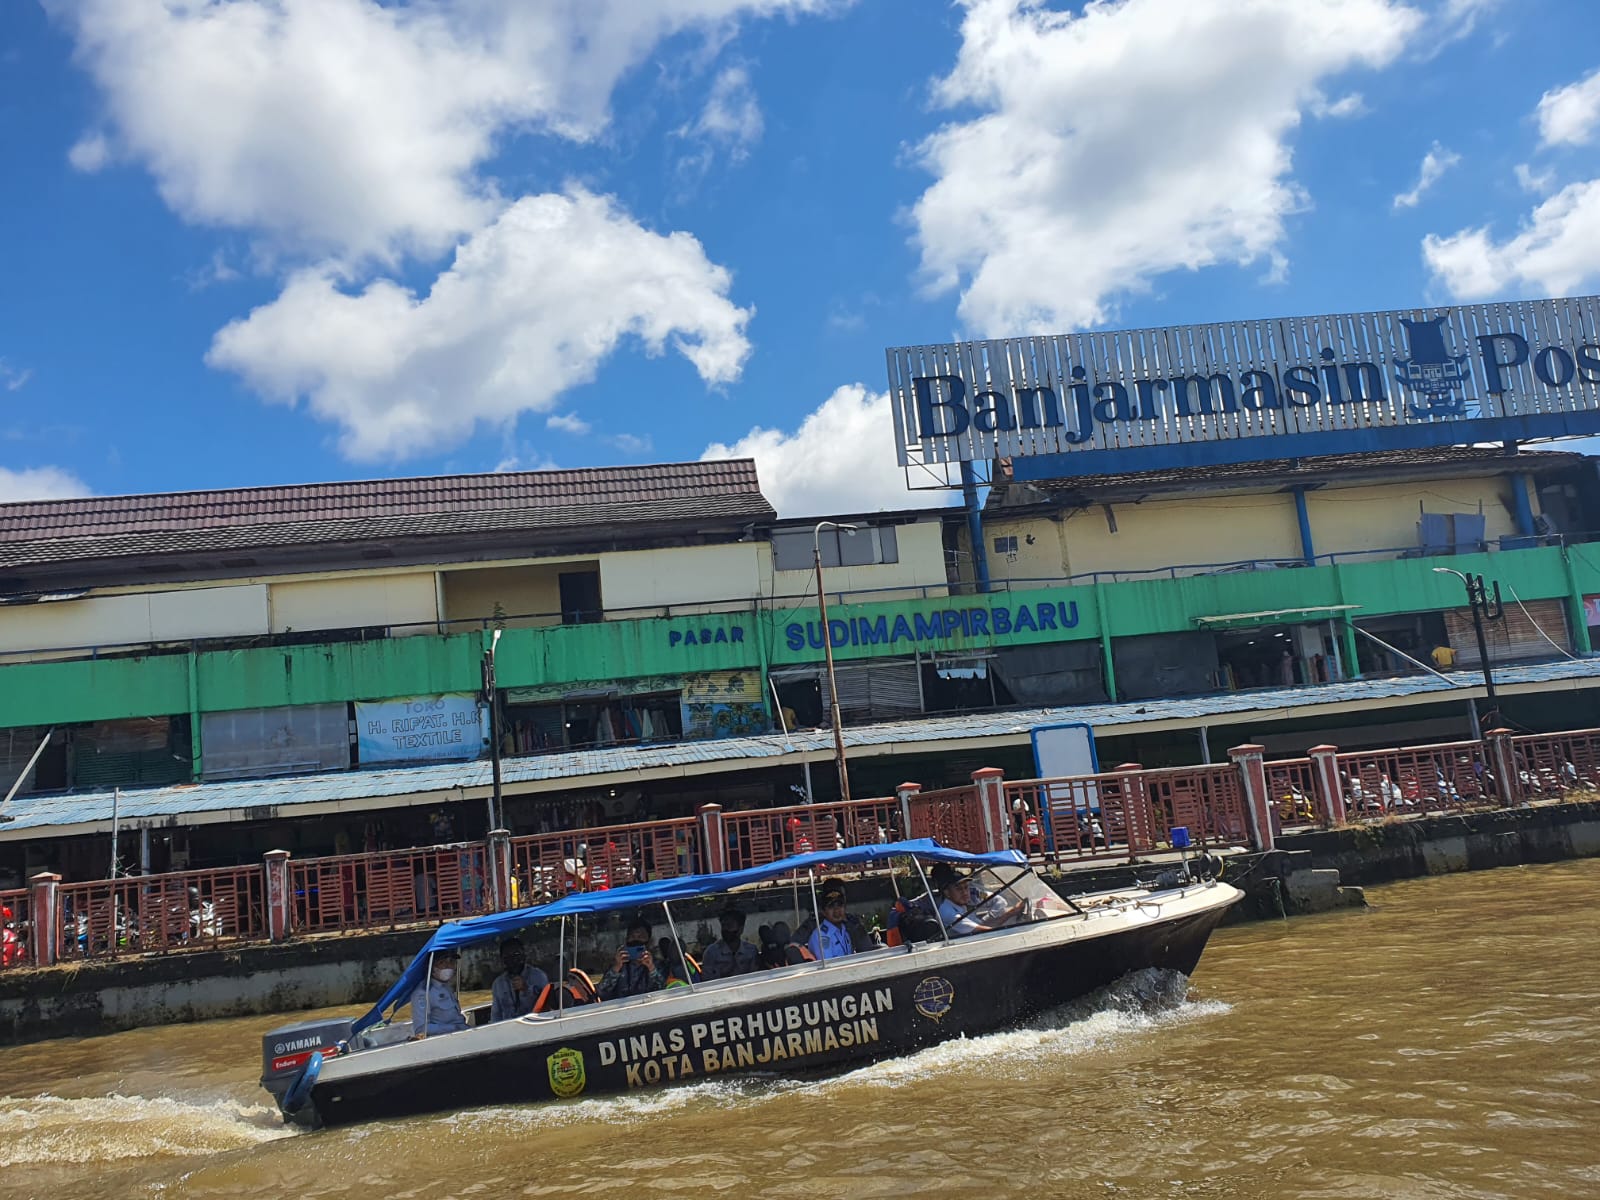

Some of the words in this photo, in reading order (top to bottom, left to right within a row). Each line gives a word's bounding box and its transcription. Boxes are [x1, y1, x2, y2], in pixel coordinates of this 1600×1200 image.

[912, 348, 1388, 445] Banjarmasin
[669, 626, 744, 648] PASAR
[368, 720, 387, 735] H.
[392, 729, 462, 750] TEXTILE
[598, 1028, 685, 1066] DINAS
[691, 988, 894, 1048] PERHUBUNGAN
[285, 1036, 322, 1052] YAMAHA
[625, 1053, 695, 1088] KOTA
[702, 1017, 879, 1073] BANJARMASIN
